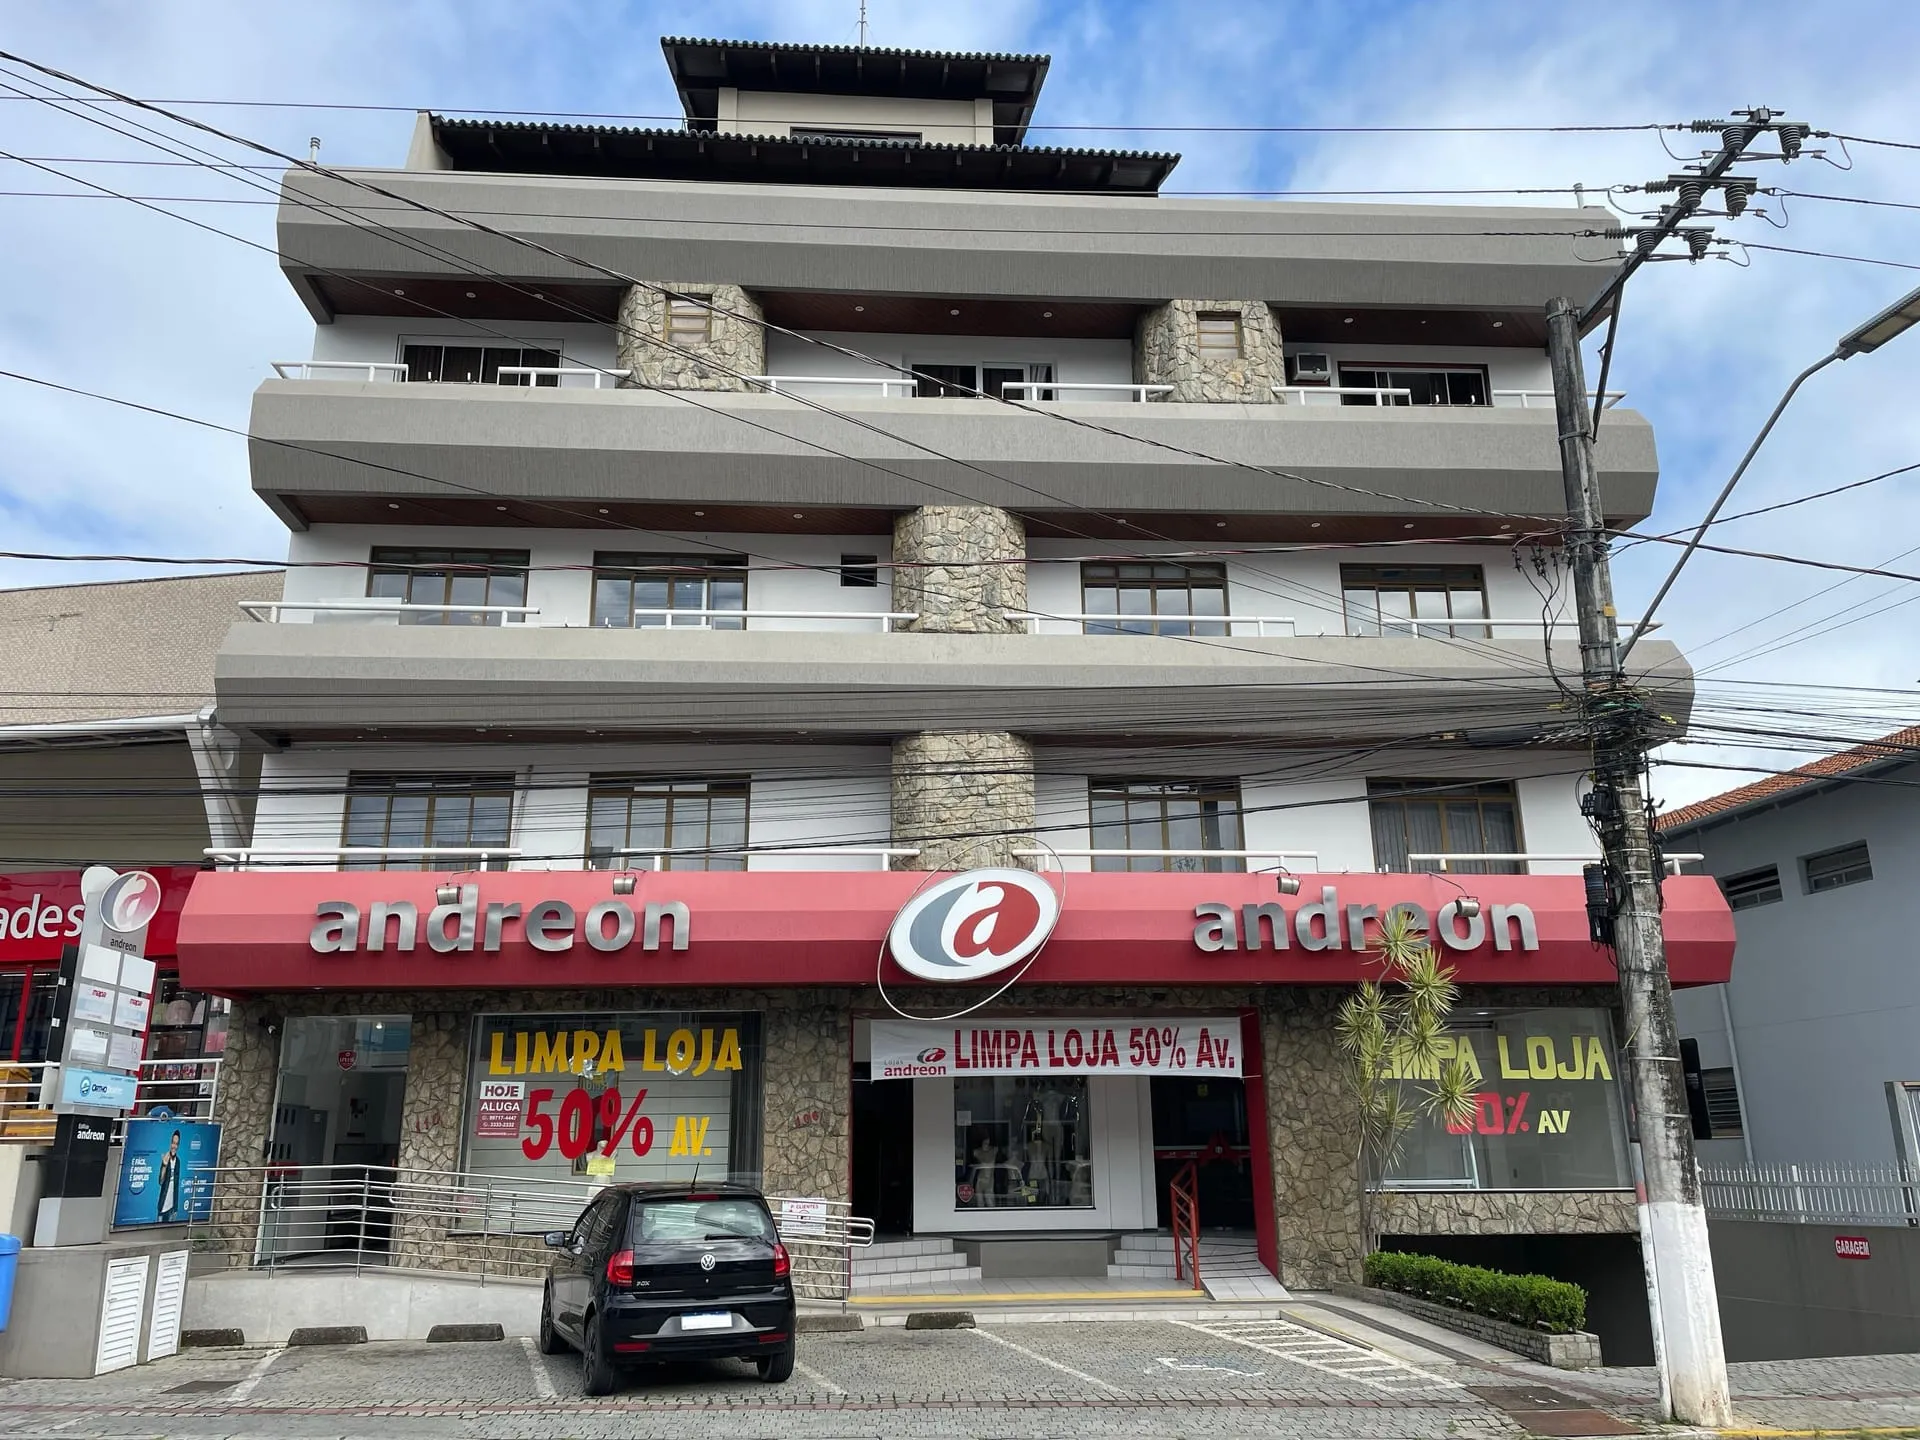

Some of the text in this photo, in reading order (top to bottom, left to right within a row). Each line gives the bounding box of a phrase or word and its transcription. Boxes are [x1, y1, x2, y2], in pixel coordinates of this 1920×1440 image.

[310, 884, 690, 952] andreon
[110, 939, 136, 952] andreon
[489, 1029, 743, 1077] LIMPA LOJA
[954, 1030, 1040, 1068] LIMPA
[1048, 1029, 1120, 1067] LOJA
[1129, 1027, 1187, 1069] 50%
[1498, 1036, 1612, 1080] LOJA
[884, 1064, 946, 1076] andreon
[485, 1086, 519, 1097] HOJE
[480, 1102, 520, 1111] ALUGA
[522, 1088, 654, 1160] 50%
[1537, 1110, 1570, 1133] AV
[77, 1129, 105, 1141] andreon
[669, 1117, 712, 1156] AV.
[1835, 1240, 1870, 1256] GARAGEM
